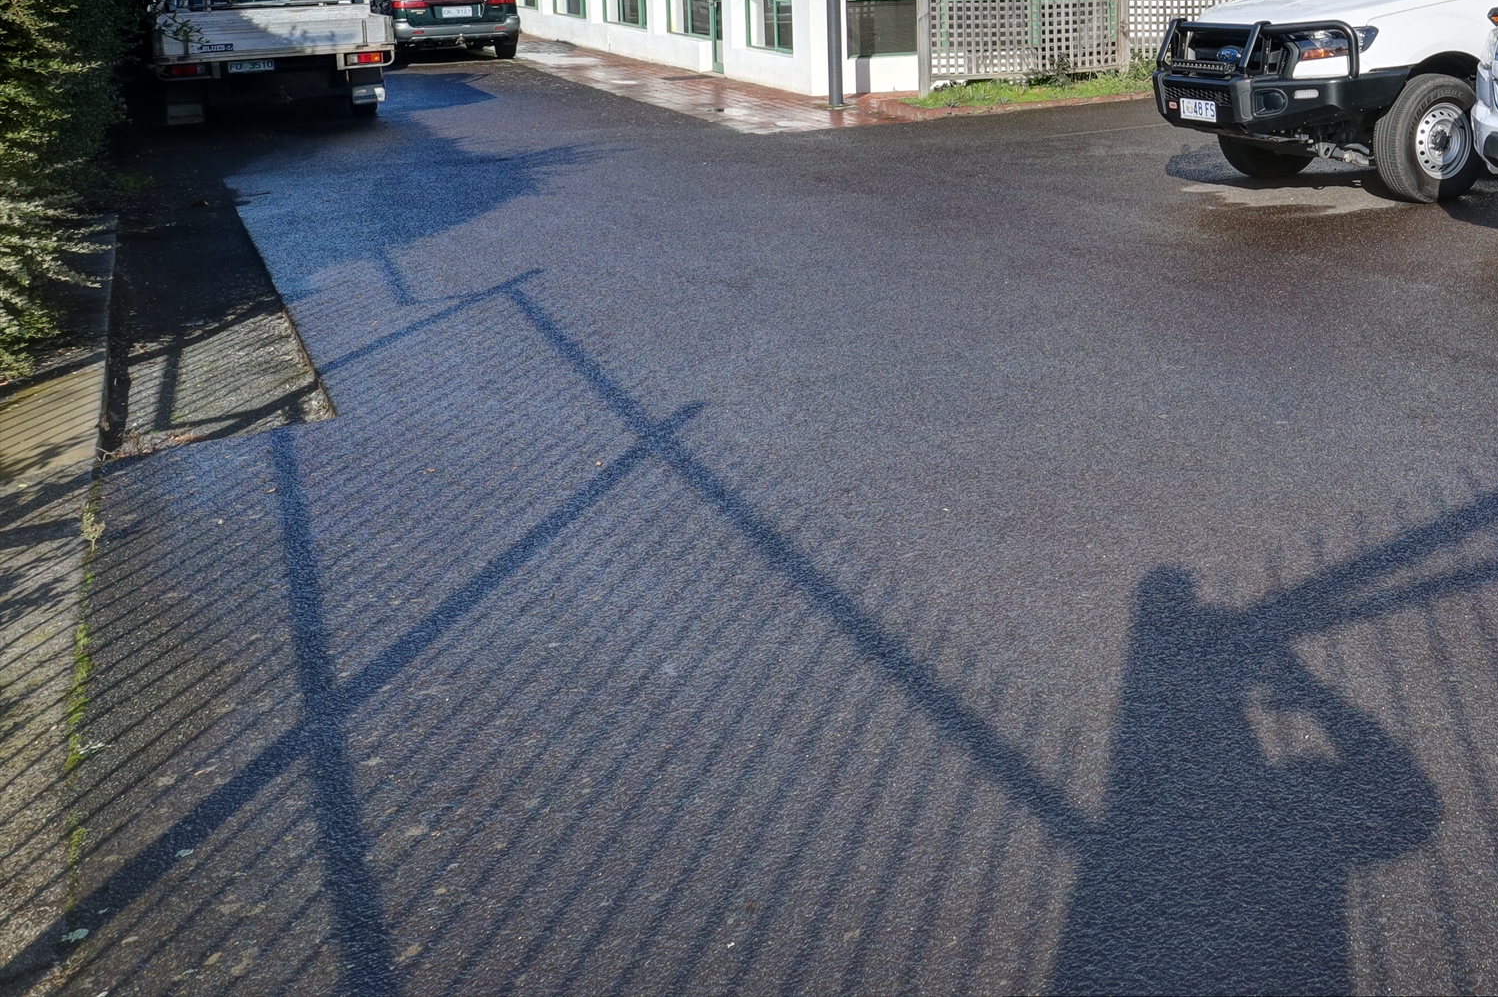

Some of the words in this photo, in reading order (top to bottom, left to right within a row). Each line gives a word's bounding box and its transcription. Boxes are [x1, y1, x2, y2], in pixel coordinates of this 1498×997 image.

[249, 60, 274, 70] 3510
[1193, 101, 1203, 116] 48
[1204, 102, 1216, 118] FS
